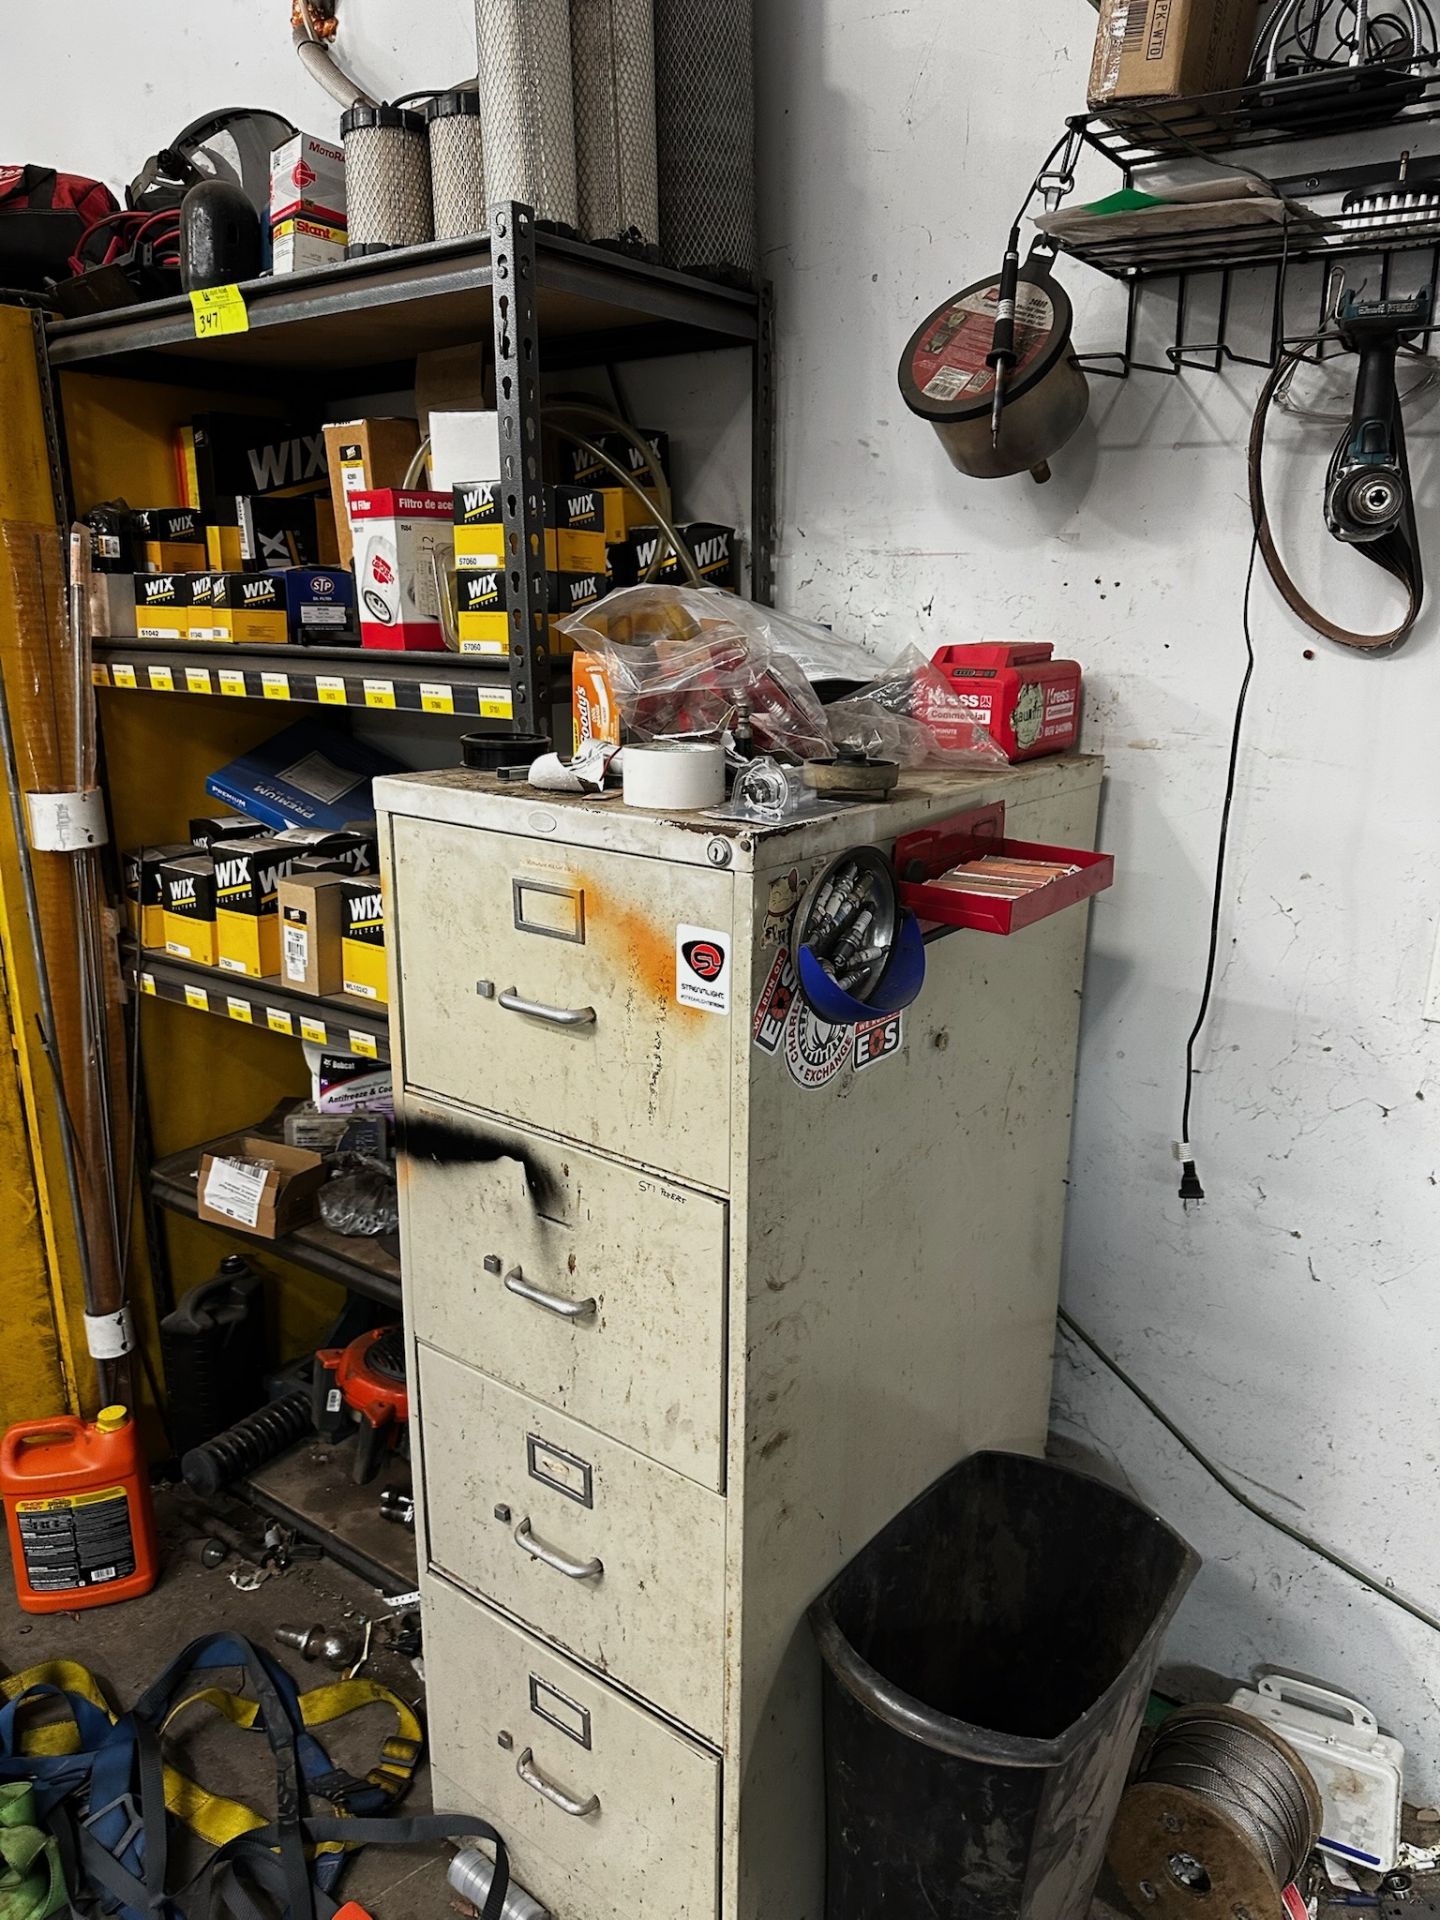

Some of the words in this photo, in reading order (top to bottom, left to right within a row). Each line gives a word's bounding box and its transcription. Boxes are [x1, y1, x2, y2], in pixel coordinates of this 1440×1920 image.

[297, 220, 330, 239] Stant
[200, 312, 217, 333] 347
[248, 433, 327, 491] WIX
[628, 437, 661, 469] WX
[399, 498, 423, 509] Filtro
[424, 500, 435, 509] de
[463, 482, 494, 512] WIX
[568, 494, 595, 516] WIX
[168, 515, 194, 533] WIX
[694, 533, 729, 567] WIX
[145, 577, 174, 596] WIX
[192, 577, 211, 596] WIX
[243, 579, 275, 598] WIX
[313, 578, 331, 592] STP
[468, 573, 498, 599] WIX
[570, 577, 597, 600] WIX
[464, 643, 481, 651] 57060
[931, 710, 986, 720] Commercial
[212, 785, 246, 807] PREMIUM
[253, 784, 316, 819] PREMIUM
[215, 857, 252, 889] WIX
[169, 878, 196, 900] WIX
[217, 891, 253, 904] FILTERS
[348, 894, 384, 921] WIX
[753, 1009, 764, 1030] WE
[762, 979, 776, 1006] RUN
[774, 955, 785, 974] ON
[804, 1035, 852, 1082] EXCHANGE
[328, 1091, 368, 1104] Antifreeze
